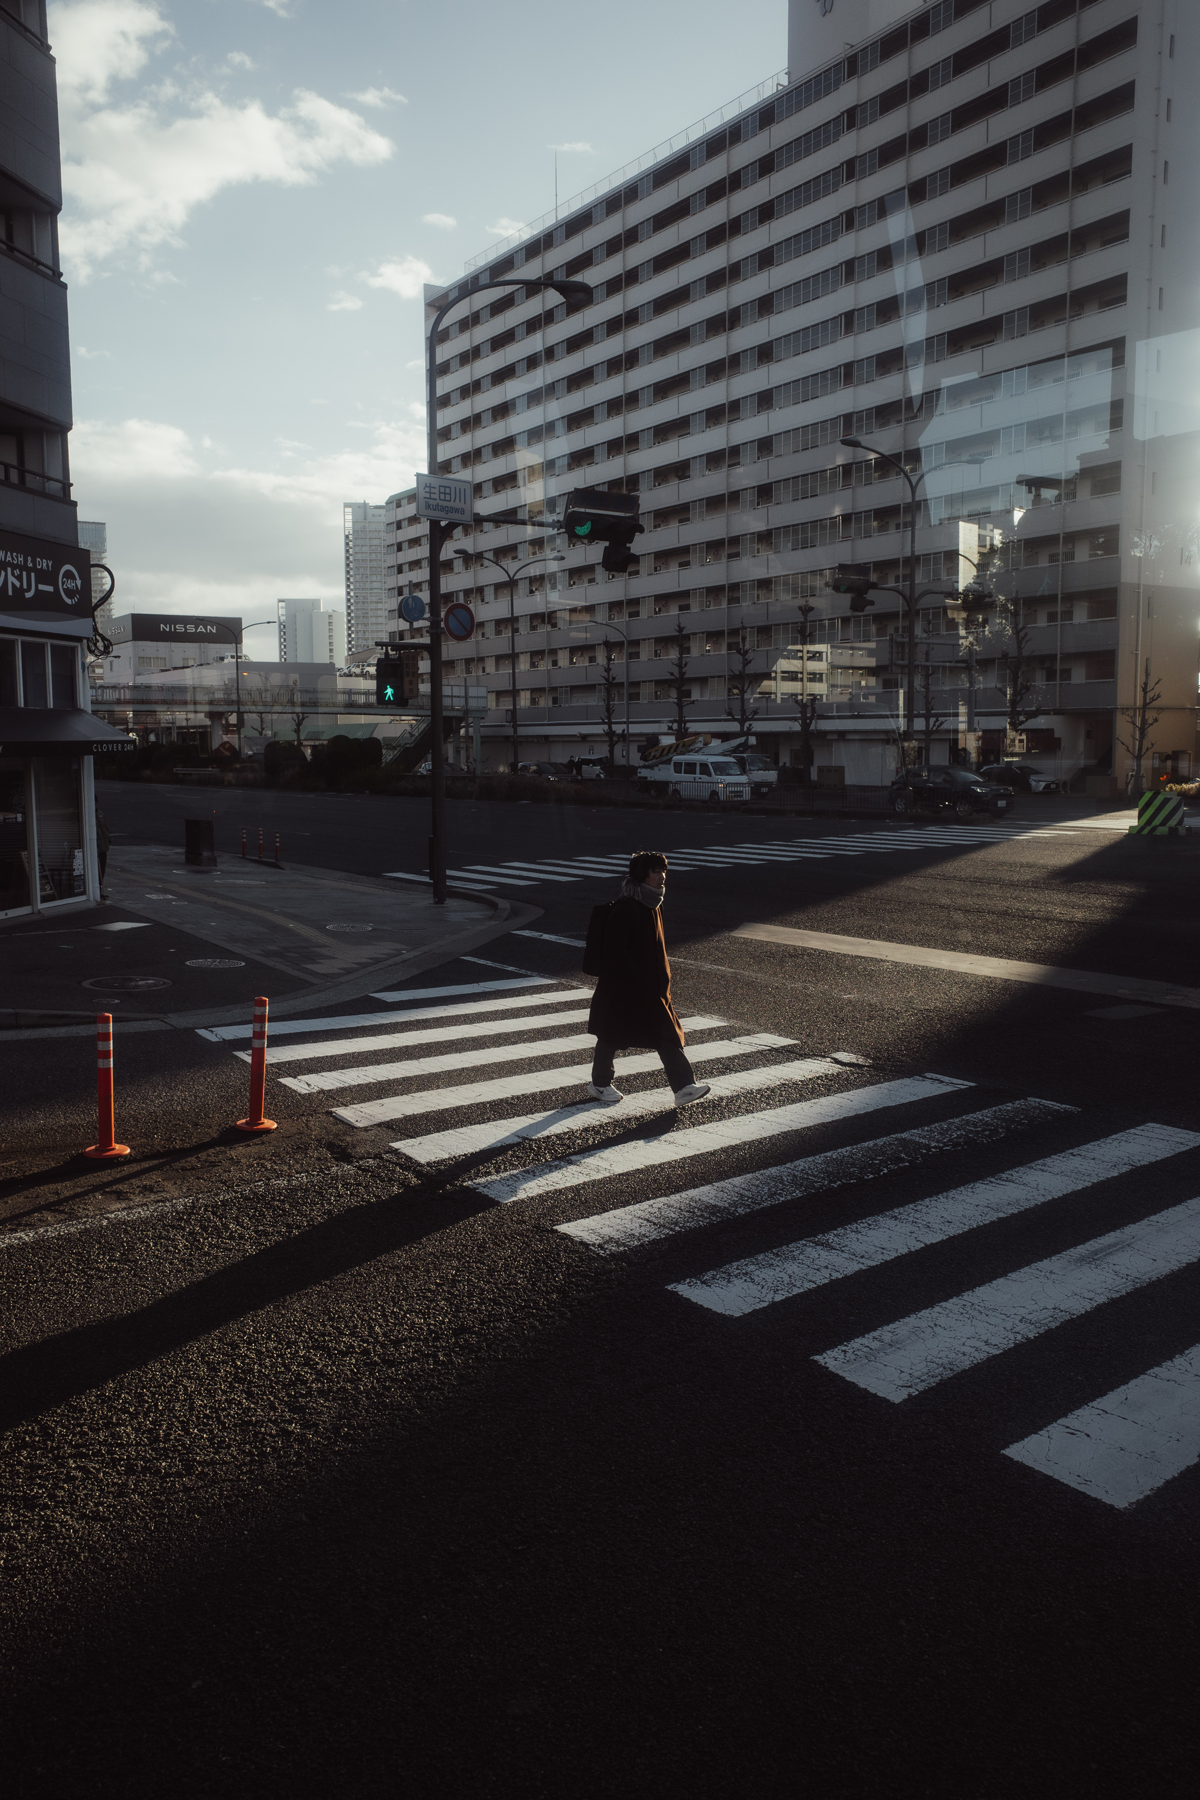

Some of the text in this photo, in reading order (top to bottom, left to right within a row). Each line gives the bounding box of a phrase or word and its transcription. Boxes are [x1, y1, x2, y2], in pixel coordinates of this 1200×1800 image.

[423, 483, 466, 505] 生田川
[424, 501, 465, 515] Ikutagawa
[27, 556, 33, 568] &
[36, 557, 53, 571] DRY
[62, 577, 76, 590] 24H
[160, 623, 217, 634] NISSAN
[92, 743, 134, 752] CLOVER 24H
